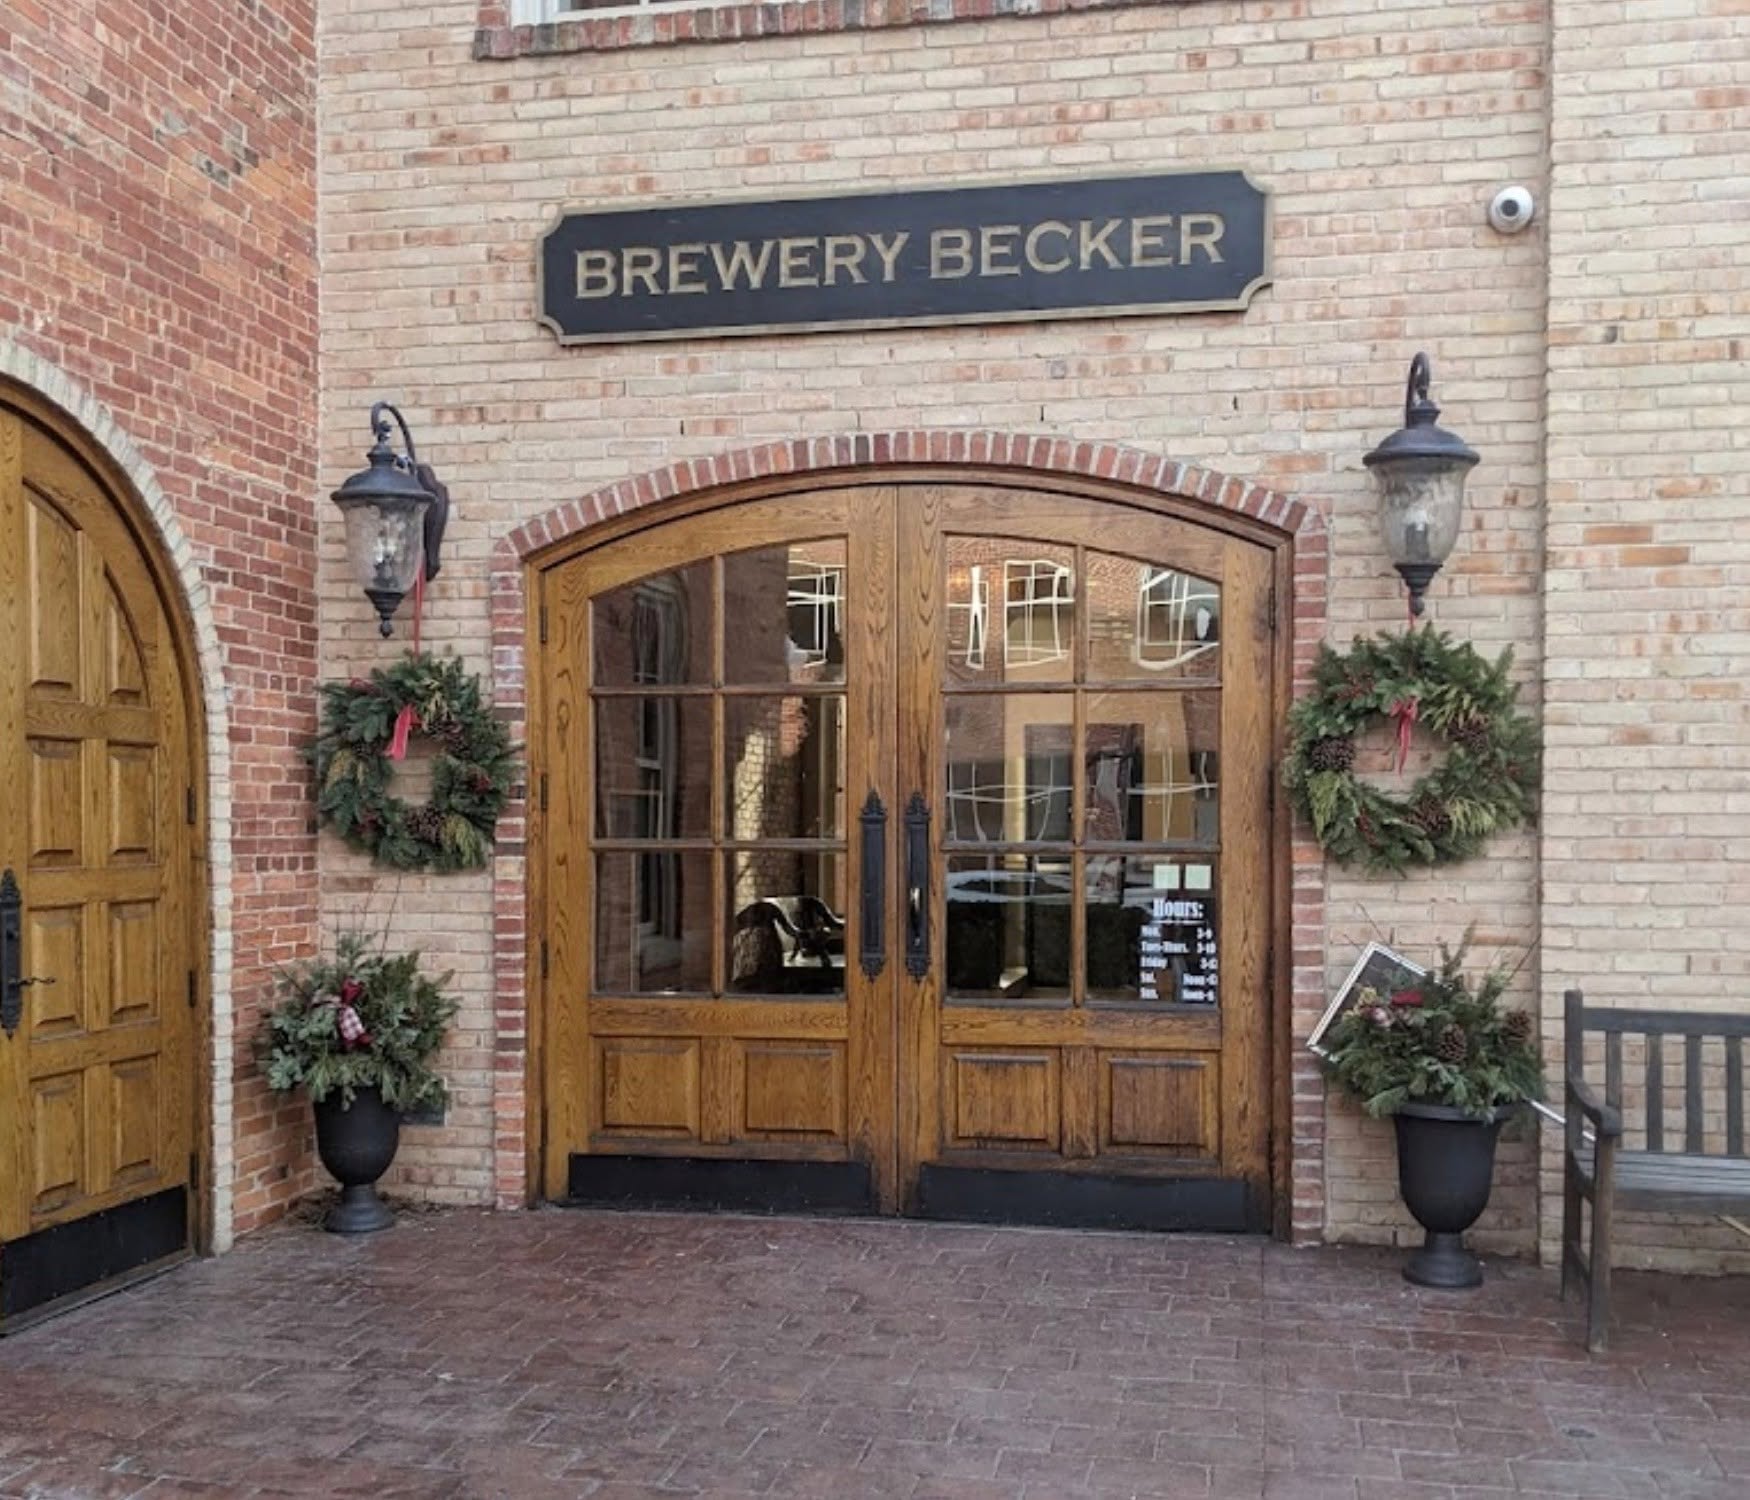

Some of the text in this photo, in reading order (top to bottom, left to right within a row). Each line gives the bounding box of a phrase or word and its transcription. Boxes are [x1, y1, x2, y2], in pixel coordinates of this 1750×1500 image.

[574, 212, 1226, 299] BREWERY BECKER
[1153, 898, 1204, 918] Hours:
